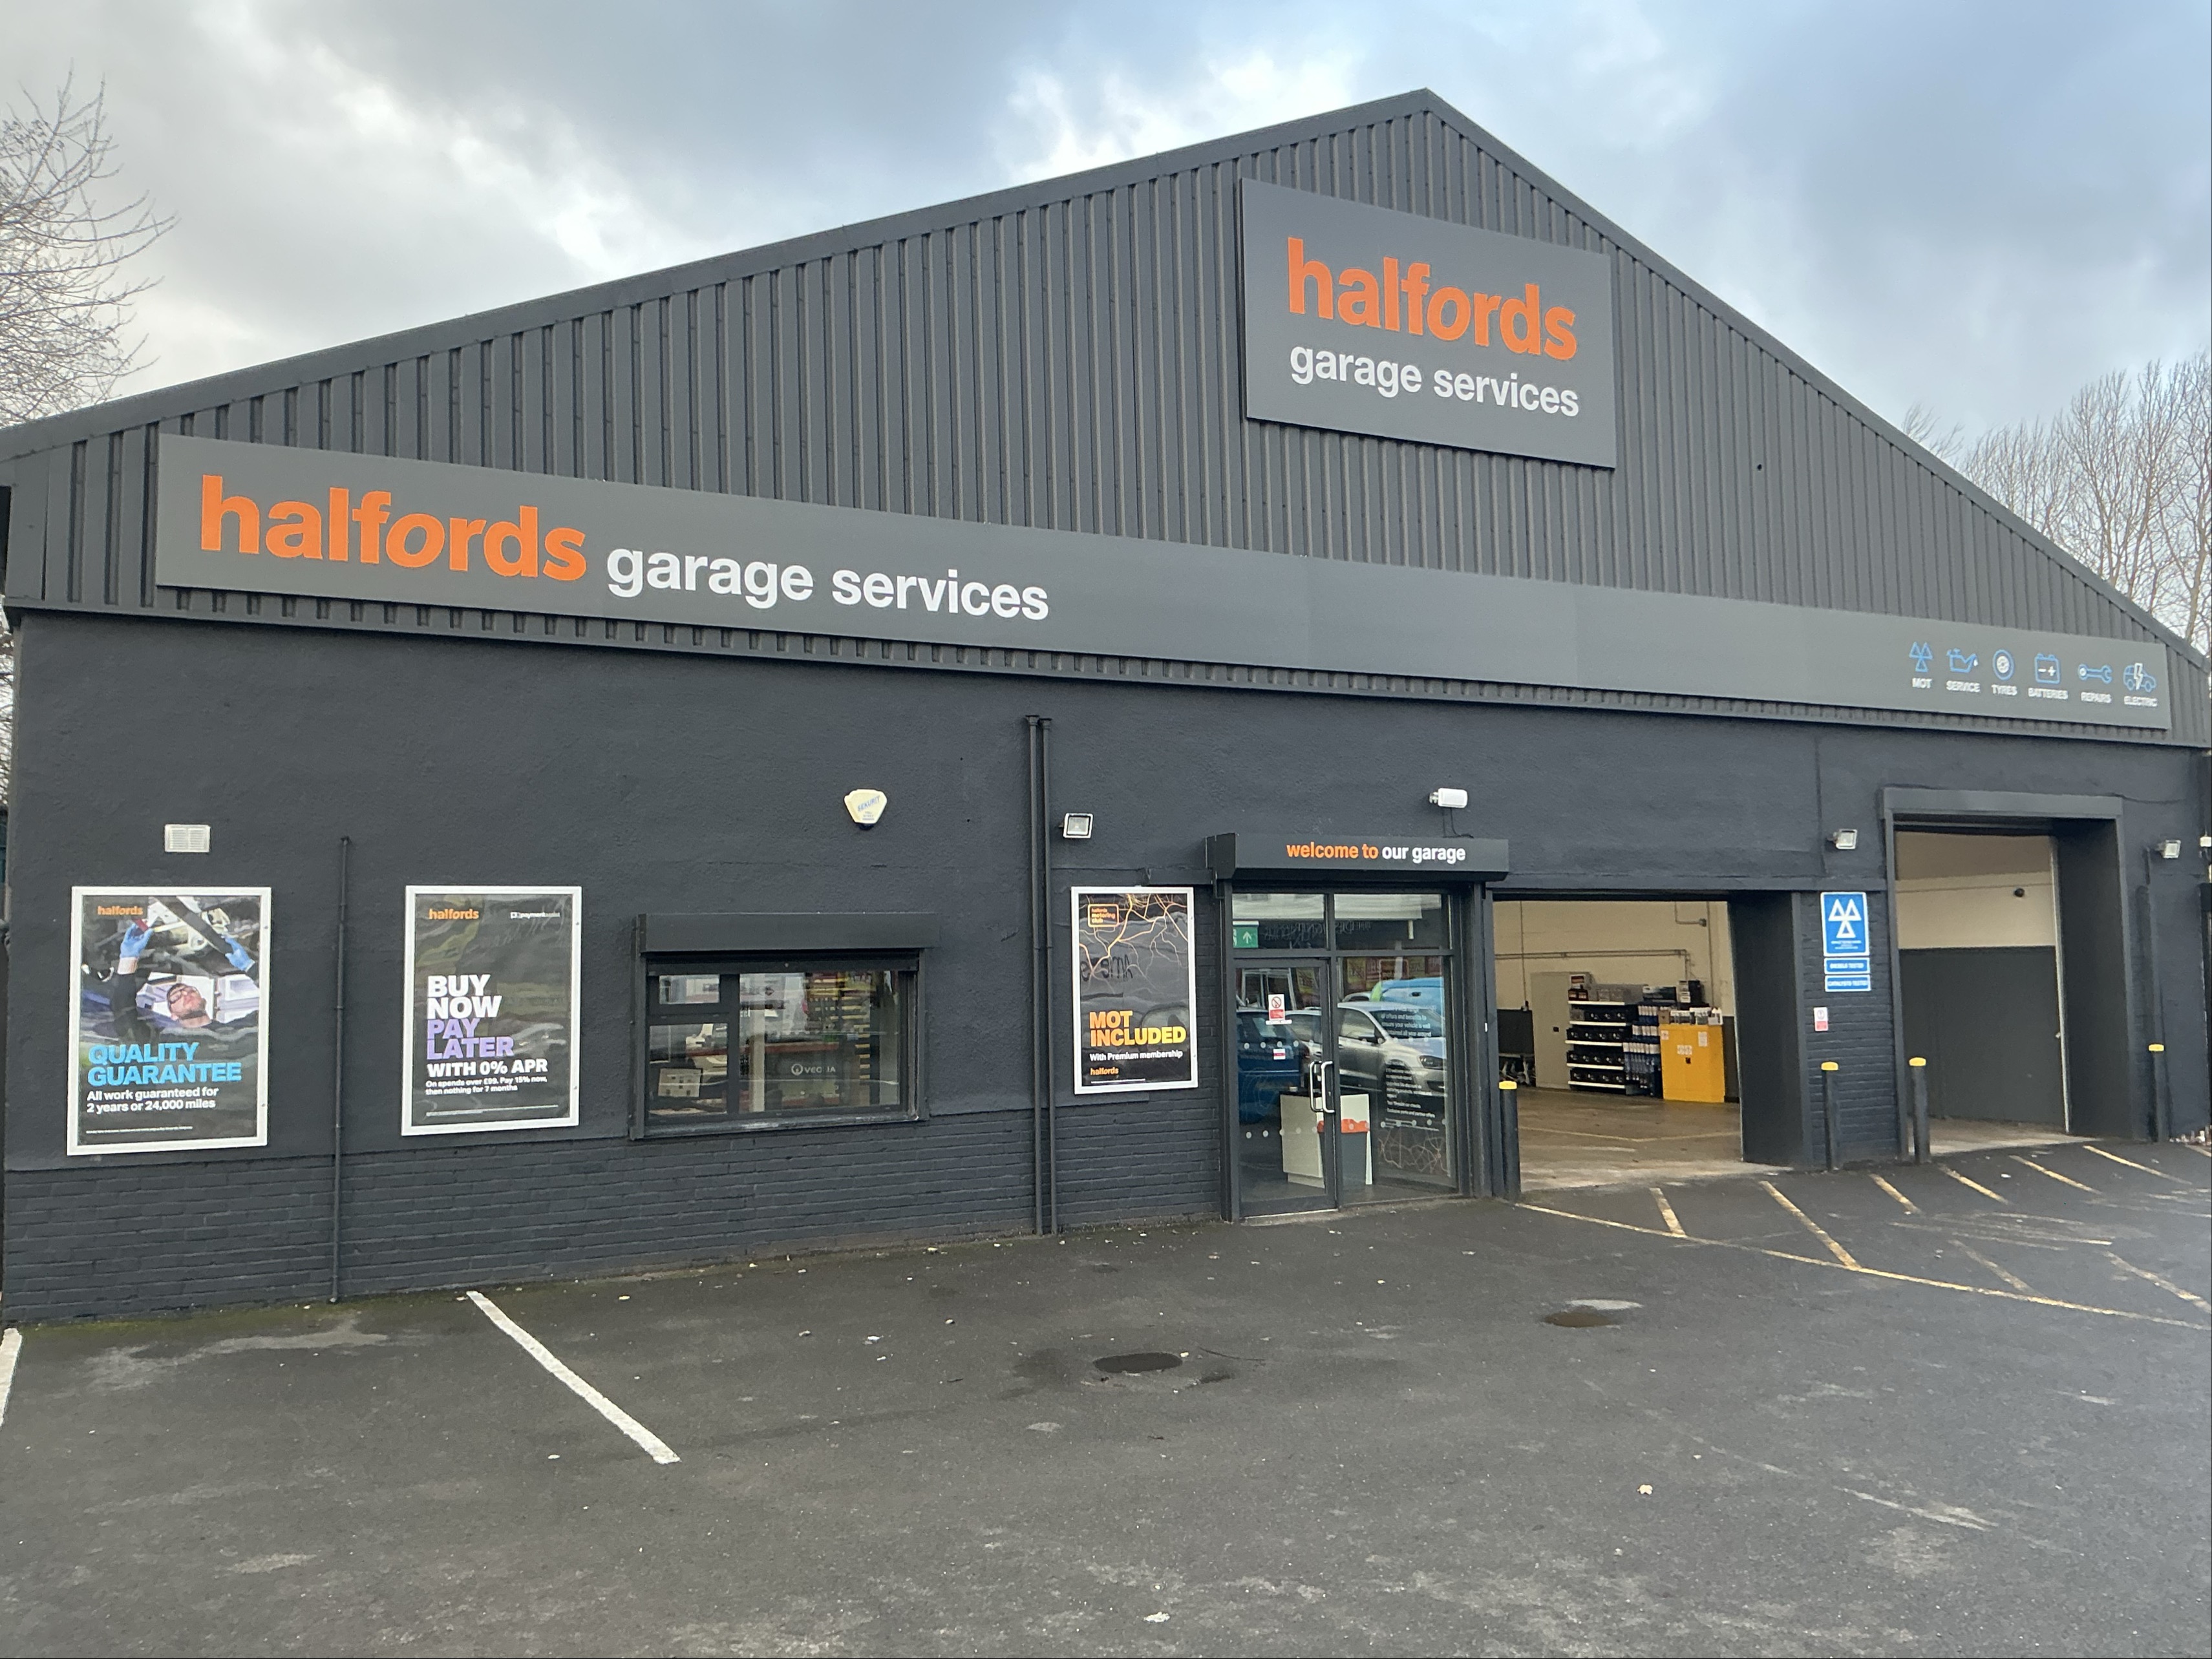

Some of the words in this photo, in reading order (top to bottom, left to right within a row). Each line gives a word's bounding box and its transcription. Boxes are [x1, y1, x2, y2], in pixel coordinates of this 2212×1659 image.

[1288, 237, 1577, 361] halfords
[1290, 345, 1422, 397] garage
[1433, 369, 1579, 417] services
[201, 474, 588, 582] halfords
[606, 547, 814, 609] garage
[832, 569, 1050, 620] services
[1912, 677, 1932, 689] MOT
[1946, 680, 1981, 693] SERVICE
[1991, 684, 2018, 696] TYRES
[2028, 687, 2068, 700] BATTERIES
[2080, 692, 2112, 704] REPAIRS
[2123, 695, 2158, 707] ELECTRIC
[1286, 841, 1359, 859] welcome
[1361, 843, 1379, 859] to
[1382, 846, 1409, 860] our
[1412, 847, 1467, 865] garage
[97, 905, 144, 916] halfords
[429, 908, 480, 920] halfords
[427, 974, 491, 997] BUY
[427, 995, 502, 1019] NOW
[1089, 1010, 1133, 1029] MOT
[427, 1018, 481, 1039] PAY
[1090, 1026, 1187, 1047] INCLUDED
[88, 1042, 199, 1065] QUALITY
[427, 1035, 515, 1060] LATER
[1089, 1053, 1107, 1061] With
[1107, 1051, 1139, 1061] Premium
[1140, 1049, 1184, 1059] membership
[87, 1062, 242, 1086] GUARANTEE
[427, 1061, 476, 1077] WITH
[479, 1061, 508, 1075] 0%
[511, 1059, 548, 1073] APR
[1090, 1066, 1119, 1075] halfords
[425, 1087, 443, 1095] then
[443, 1086, 471, 1095] nothing
[438, 1079, 465, 1088] spends
[500, 1077, 514, 1085] Pay
[87, 1090, 102, 1101] All
[104, 1089, 133, 1101] work
[134, 1086, 200, 1102] guaranteed
[202, 1086, 220, 1097] for
[86, 1103, 94, 1113] 2
[96, 1102, 129, 1115] years
[130, 1102, 144, 1111] or
[144, 1099, 184, 1112] 24,000
[185, 1098, 216, 1109] miles
